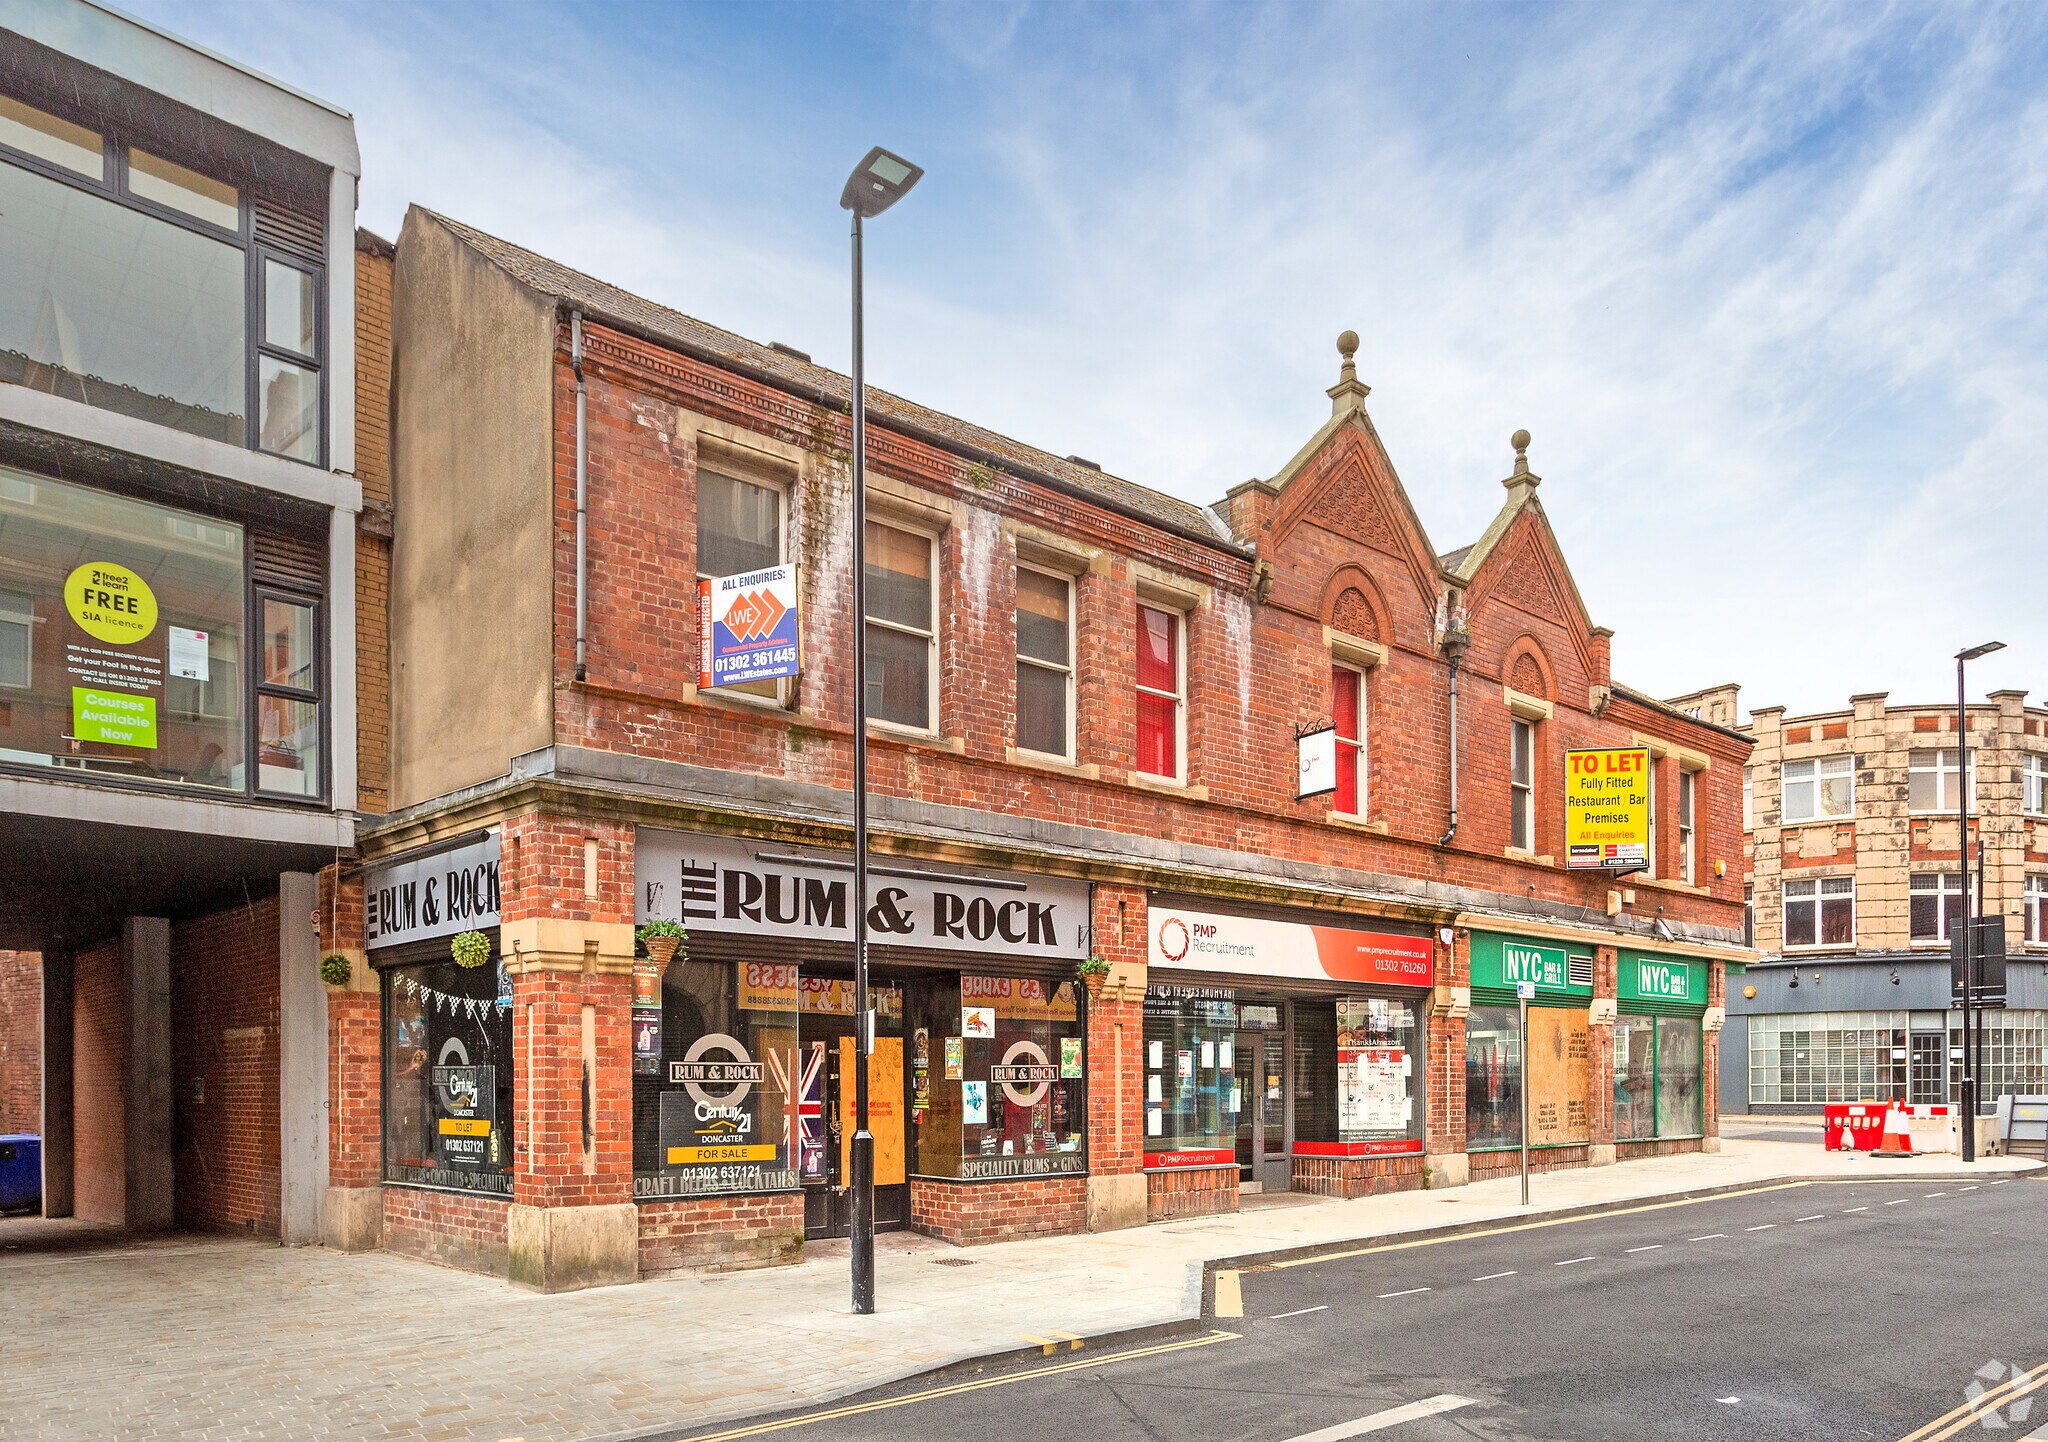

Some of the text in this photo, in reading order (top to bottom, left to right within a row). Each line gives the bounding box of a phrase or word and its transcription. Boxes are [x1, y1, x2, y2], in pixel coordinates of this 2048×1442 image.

[102, 572, 128, 584] free2
[102, 580, 128, 592] learn
[722, 570, 786, 591] ALL ENQUIRIES:
[84, 588, 138, 614] FREE
[82, 611, 144, 630] SIA licence
[728, 608, 753, 626] LWE
[702, 596, 710, 672] BUSINESS UNAFFECTED
[115, 652, 137, 660] SECURITY
[138, 655, 161, 663] COURSES
[715, 648, 796, 672] 01302 361445
[84, 658, 101, 666] your
[102, 660, 119, 669] Foot
[120, 662, 128, 670] in
[130, 664, 142, 672] the
[143, 666, 161, 675] door
[723, 666, 788, 682] www.LWEstates.com
[68, 667, 98, 676] CONTACT
[119, 674, 138, 683] 01302
[86, 694, 145, 712] Courses
[81, 710, 150, 728] Available
[101, 727, 133, 741] Now
[1570, 753, 1645, 774] TO LET
[1581, 777, 1633, 791] Fully Fitted
[1569, 795, 1620, 806] Restaurant
[1629, 794, 1645, 805] Bar
[1585, 812, 1629, 823] Premises
[1580, 831, 1635, 840] All Enquiries
[368, 860, 500, 946] THE RUM & ROCK
[681, 859, 1058, 945] THE RUM & ROCK
[1193, 923, 1217, 938] PMP
[1193, 938, 1255, 957] Recruitment
[1356, 945, 1427, 959] www.pmprecruitment.co.uk
[1375, 959, 1426, 975] 01302 761260
[1507, 949, 1542, 983] NYC
[1544, 961, 1561, 972] BAR &
[1544, 972, 1561, 984] GRILL
[1641, 965, 1669, 993] NYC
[1671, 975, 1685, 986] BAR &
[1671, 985, 1685, 995] GRILL
[841, 991, 889, 1014] RCK
[675, 1065, 760, 1080] RUM & ROCK
[994, 1068, 1056, 1080] RUM & ROCK
[450, 1075, 473, 1095] Century
[470, 1088, 477, 1107] 21
[695, 1100, 743, 1122] Century
[456, 1123, 473, 1132] TO LET
[737, 1113, 751, 1132] 21
[446, 1139, 484, 1153] 01302 637121
[702, 1135, 743, 1143] DONCASTER
[697, 1148, 748, 1159] FOR SALE
[683, 1165, 760, 1180] 01302 637121
[964, 1156, 1083, 1178] SPECIALITY RUMS GINS
[431, 1168, 464, 1187] COCKTAILS
[469, 1172, 507, 1192] SPECIALITY
[633, 1176, 676, 1196] CRAFT
[731, 1170, 795, 1191] COCKTAILS
